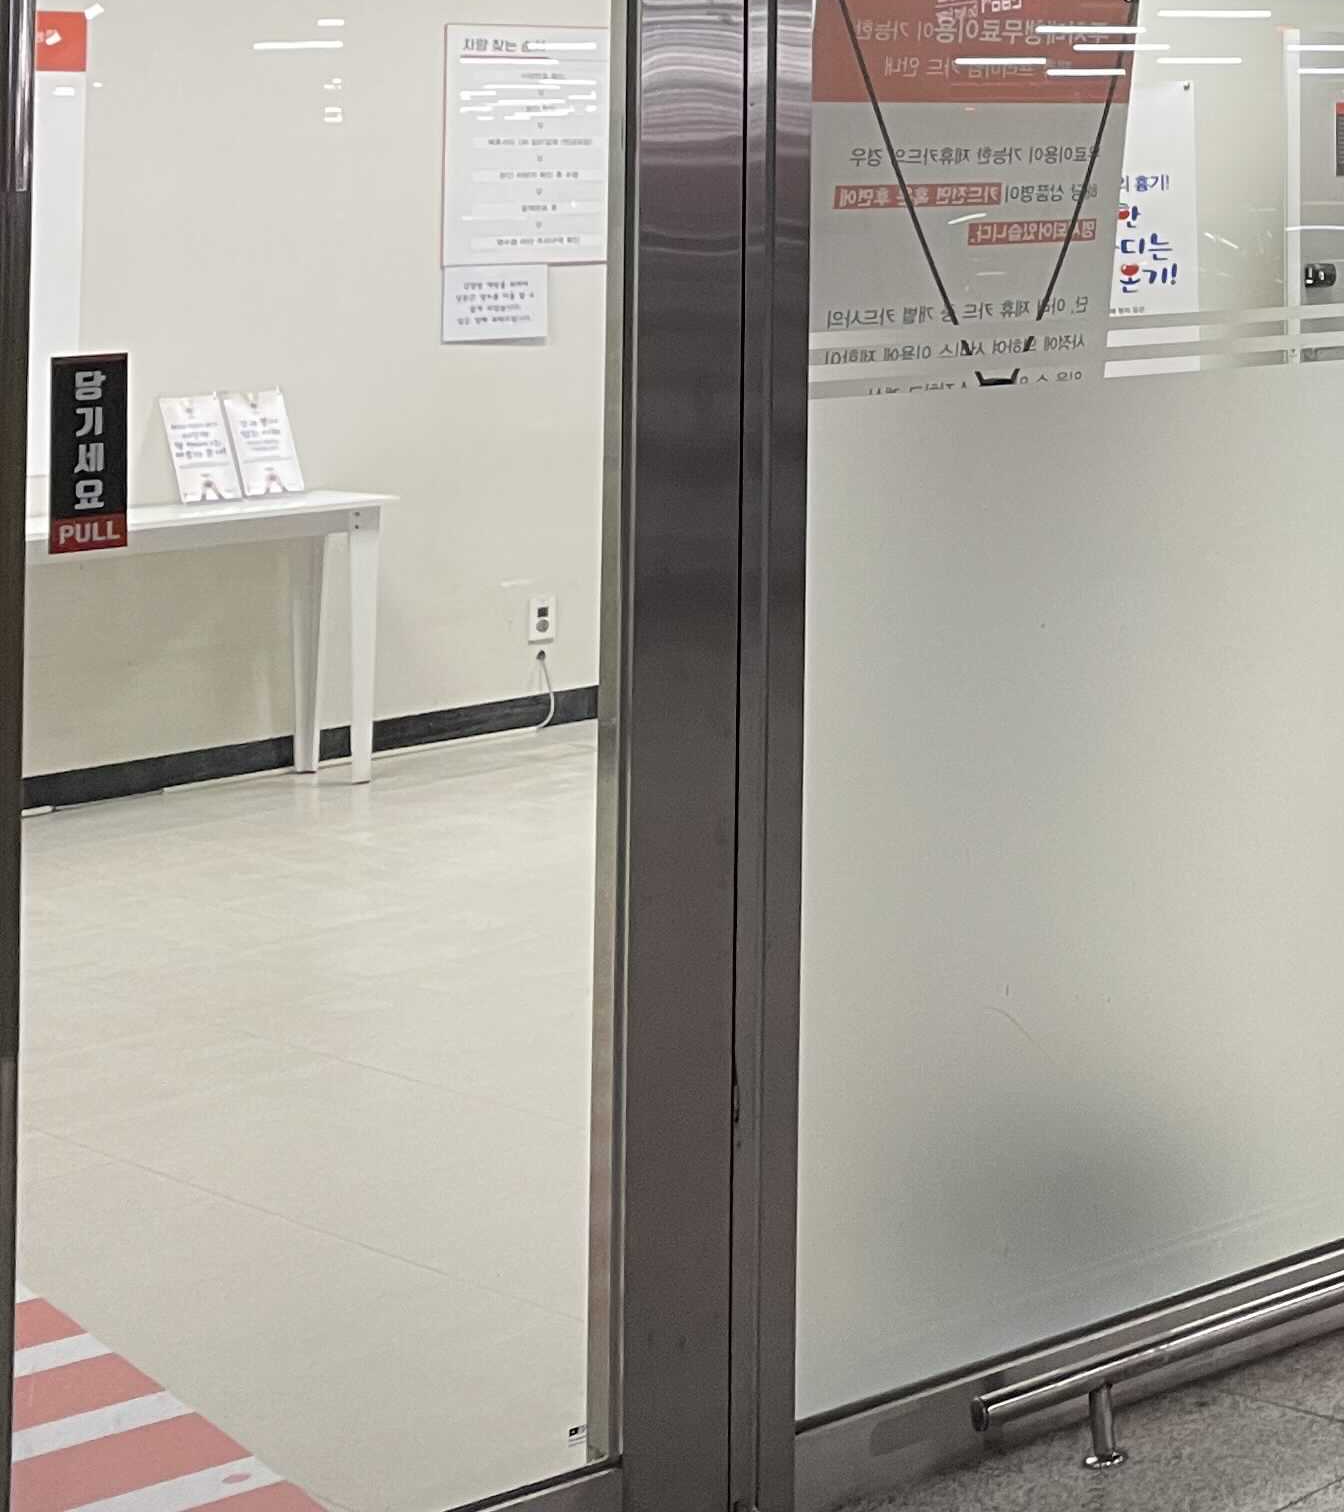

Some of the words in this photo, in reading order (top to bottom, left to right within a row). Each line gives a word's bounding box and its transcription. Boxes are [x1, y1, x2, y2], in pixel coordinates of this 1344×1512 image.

[1120, 233, 1174, 261] 디는
[74, 370, 107, 510] 당기세요
[58, 520, 121, 545] PULL
